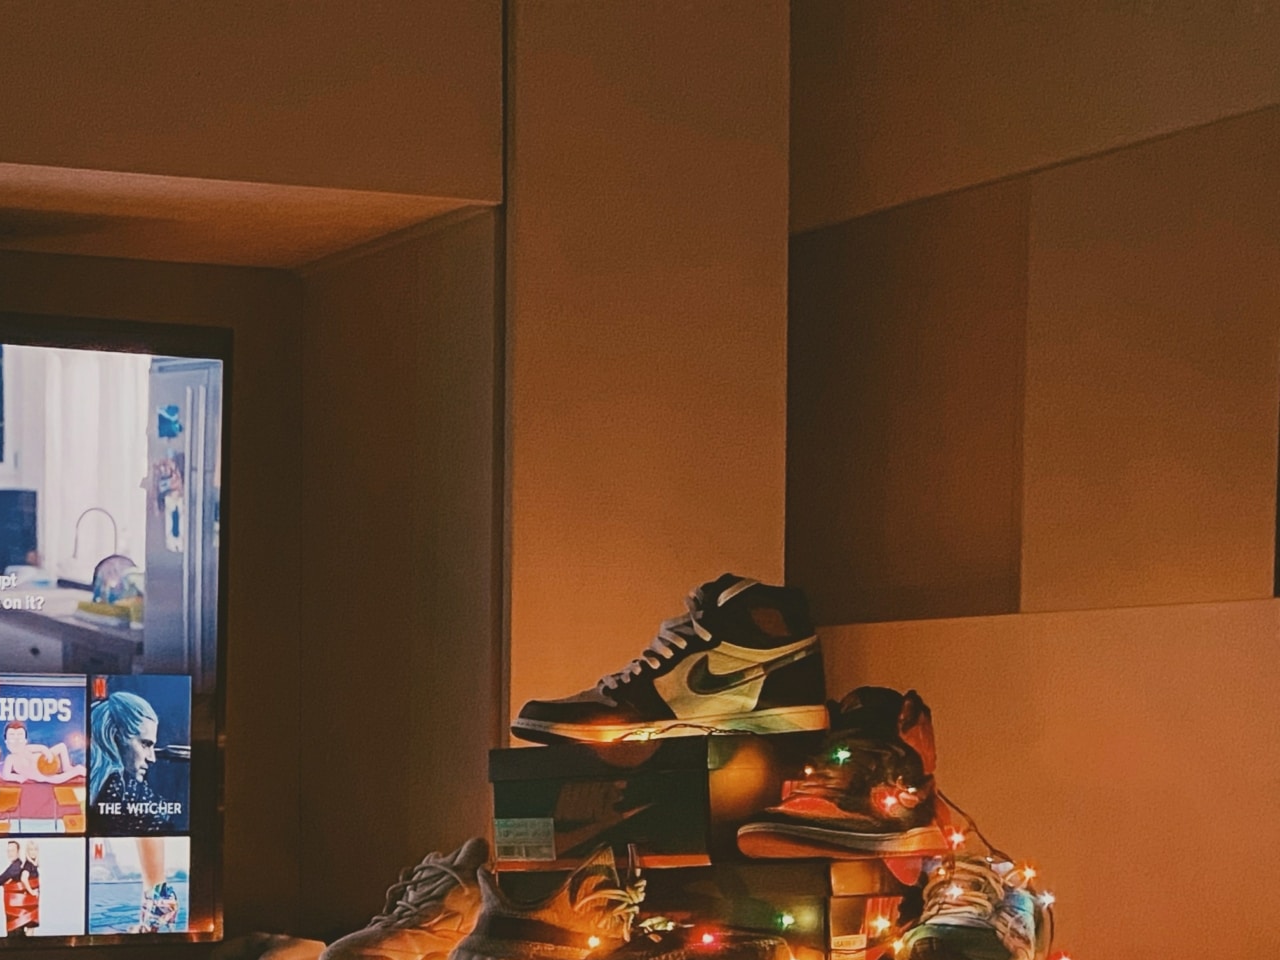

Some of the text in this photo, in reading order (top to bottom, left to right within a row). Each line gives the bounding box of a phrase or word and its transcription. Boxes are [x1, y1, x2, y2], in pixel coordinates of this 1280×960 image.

[3, 597, 22, 609] on
[25, 594, 45, 611] it?
[97, 802, 182, 815] THE WITCHER
